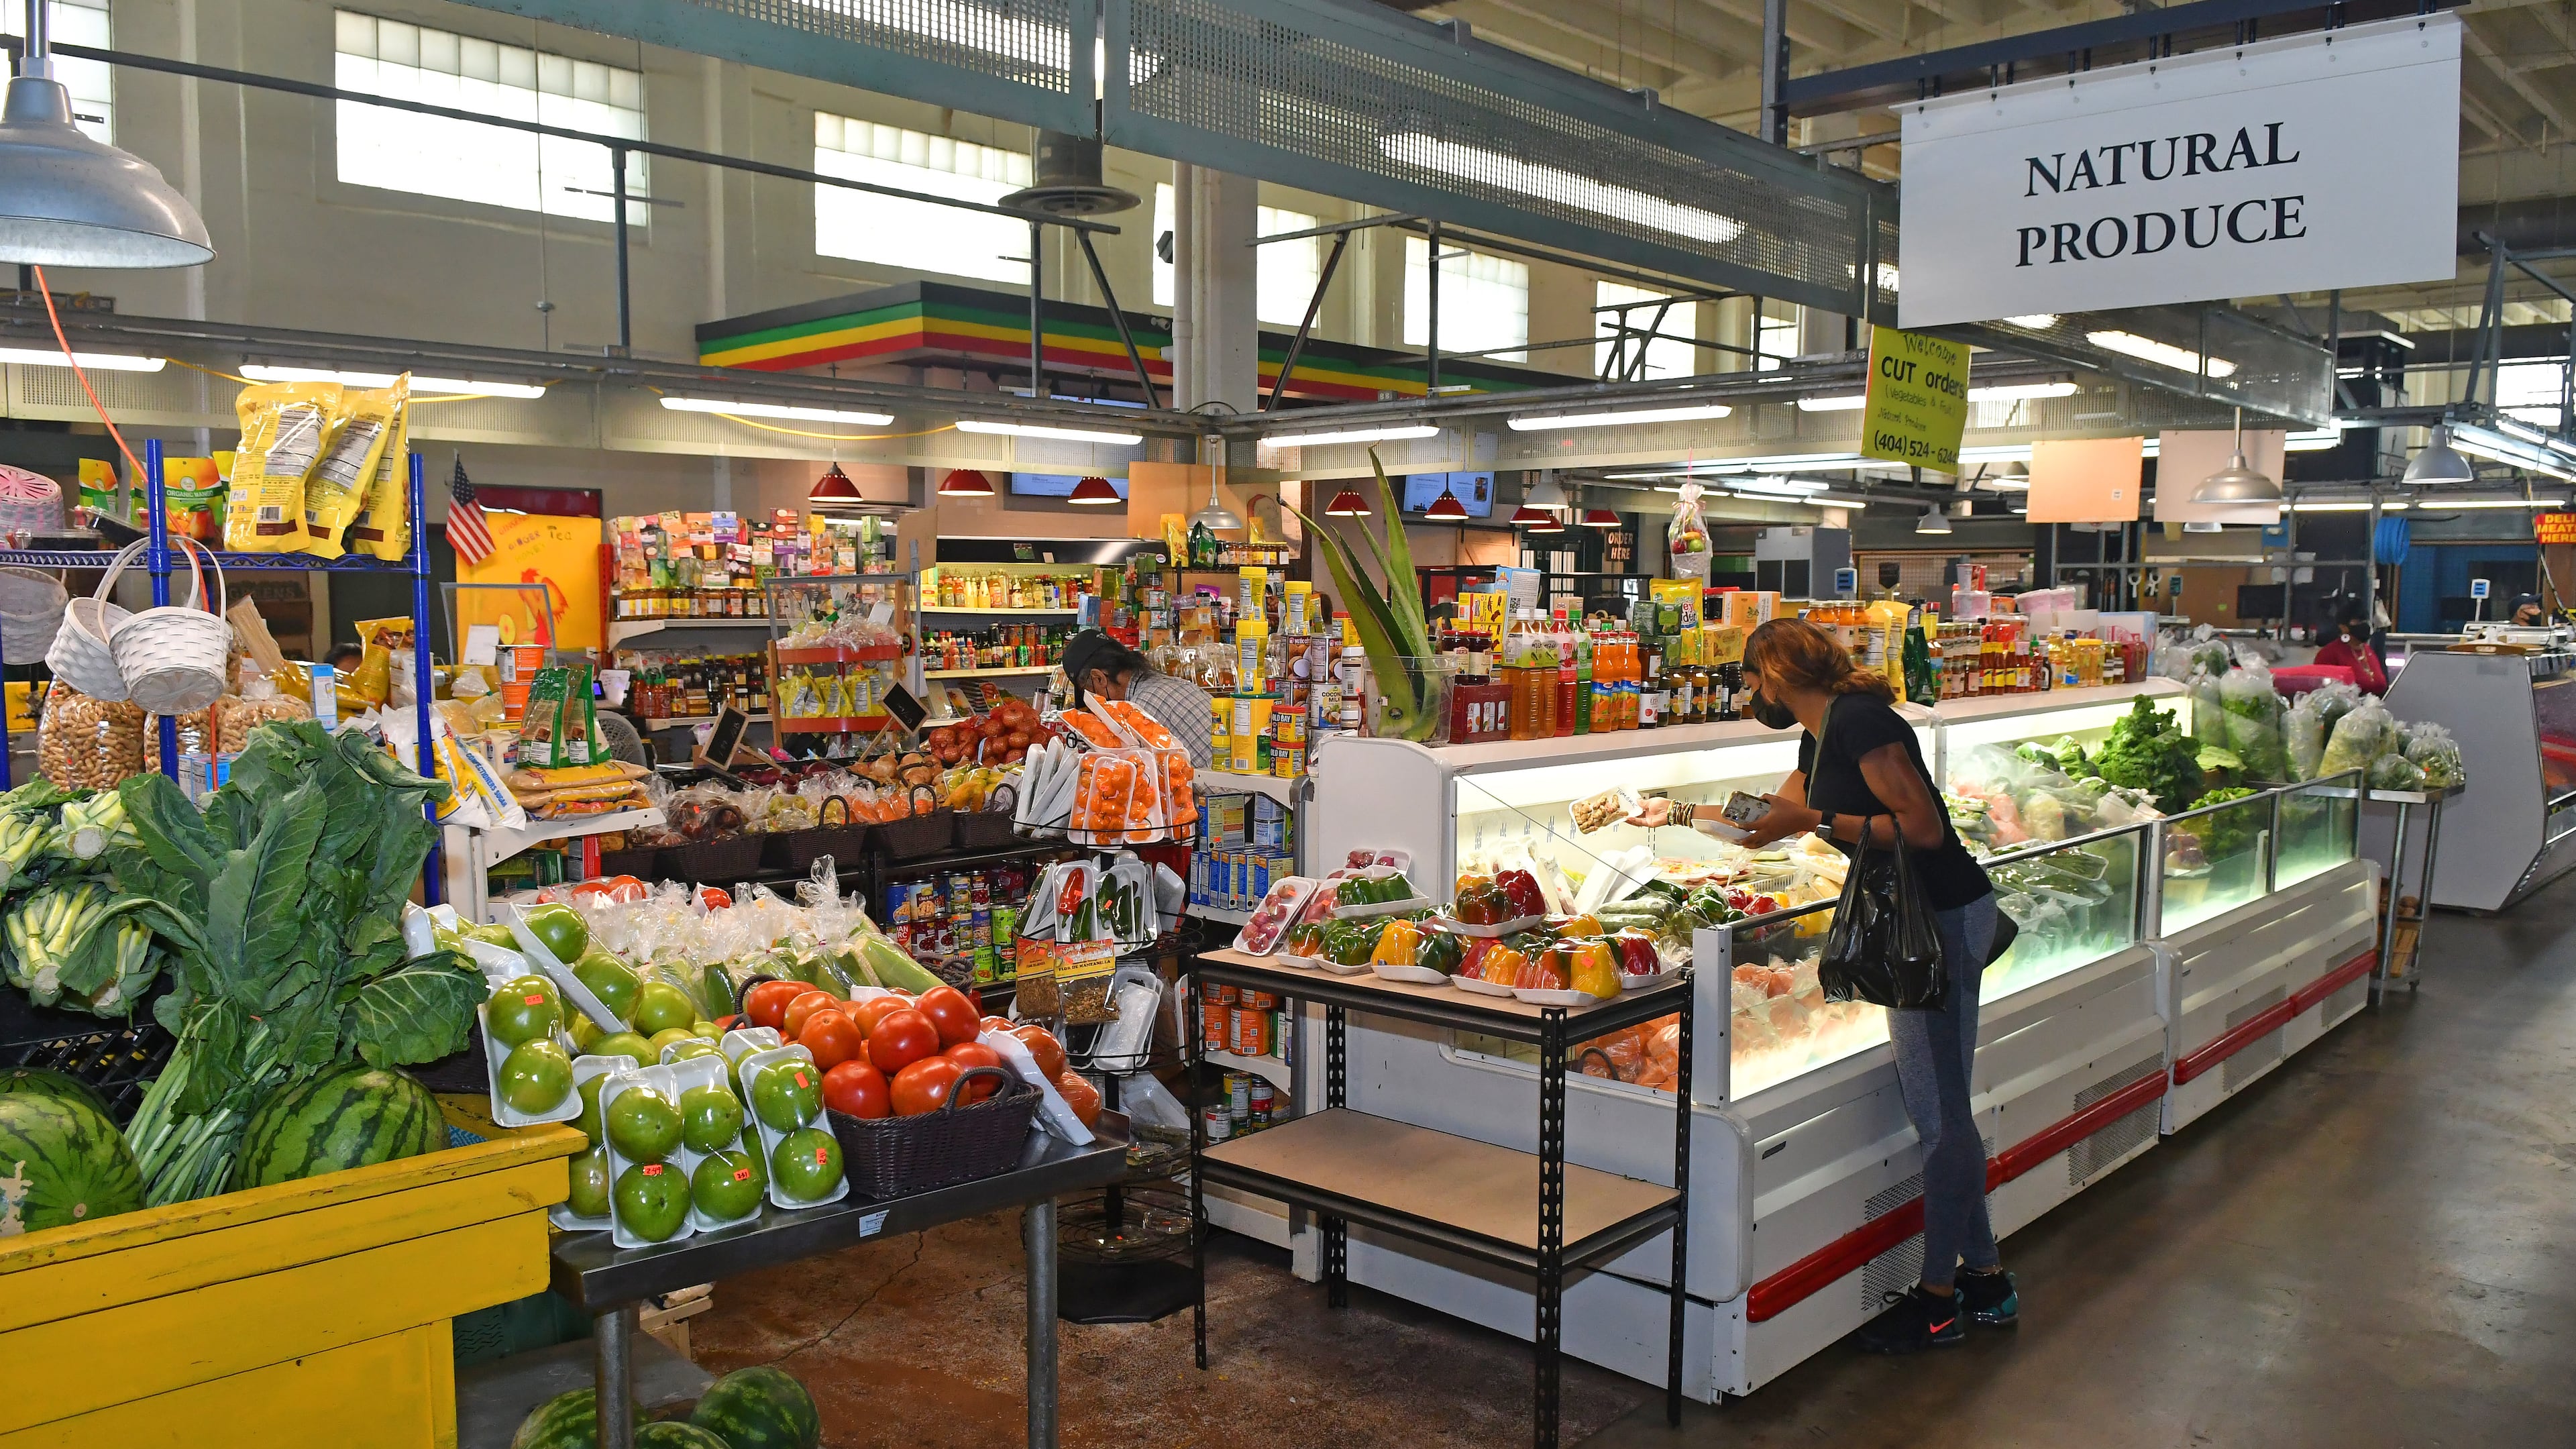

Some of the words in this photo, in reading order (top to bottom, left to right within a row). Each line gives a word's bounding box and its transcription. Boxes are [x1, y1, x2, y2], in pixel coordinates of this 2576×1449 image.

[2023, 121, 2300, 197] NATURAL
[2015, 195, 2307, 268] PRODUCE
[1904, 333, 1957, 366] Welcome
[1881, 356, 1917, 384] CUT
[1925, 371, 1964, 400] orders
[1874, 429, 1907, 456] (404)
[166, 490, 194, 498] ORGANIC
[2544, 513, 2576, 523] DELI
[547, 525, 573, 541] Tea
[1608, 531, 1633, 545] ORDER
[2541, 533, 2576, 543] HERE
[1611, 547, 1631, 559] HERE
[1272, 713, 1280, 722] OLD
[1281, 714, 1291, 723] BAY
[1270, 748, 1278, 757] OLD
[1279, 749, 1288, 758] BAY
[466, 753, 497, 792] CONFECTIONERS
[494, 790, 507, 807] SUGAR
